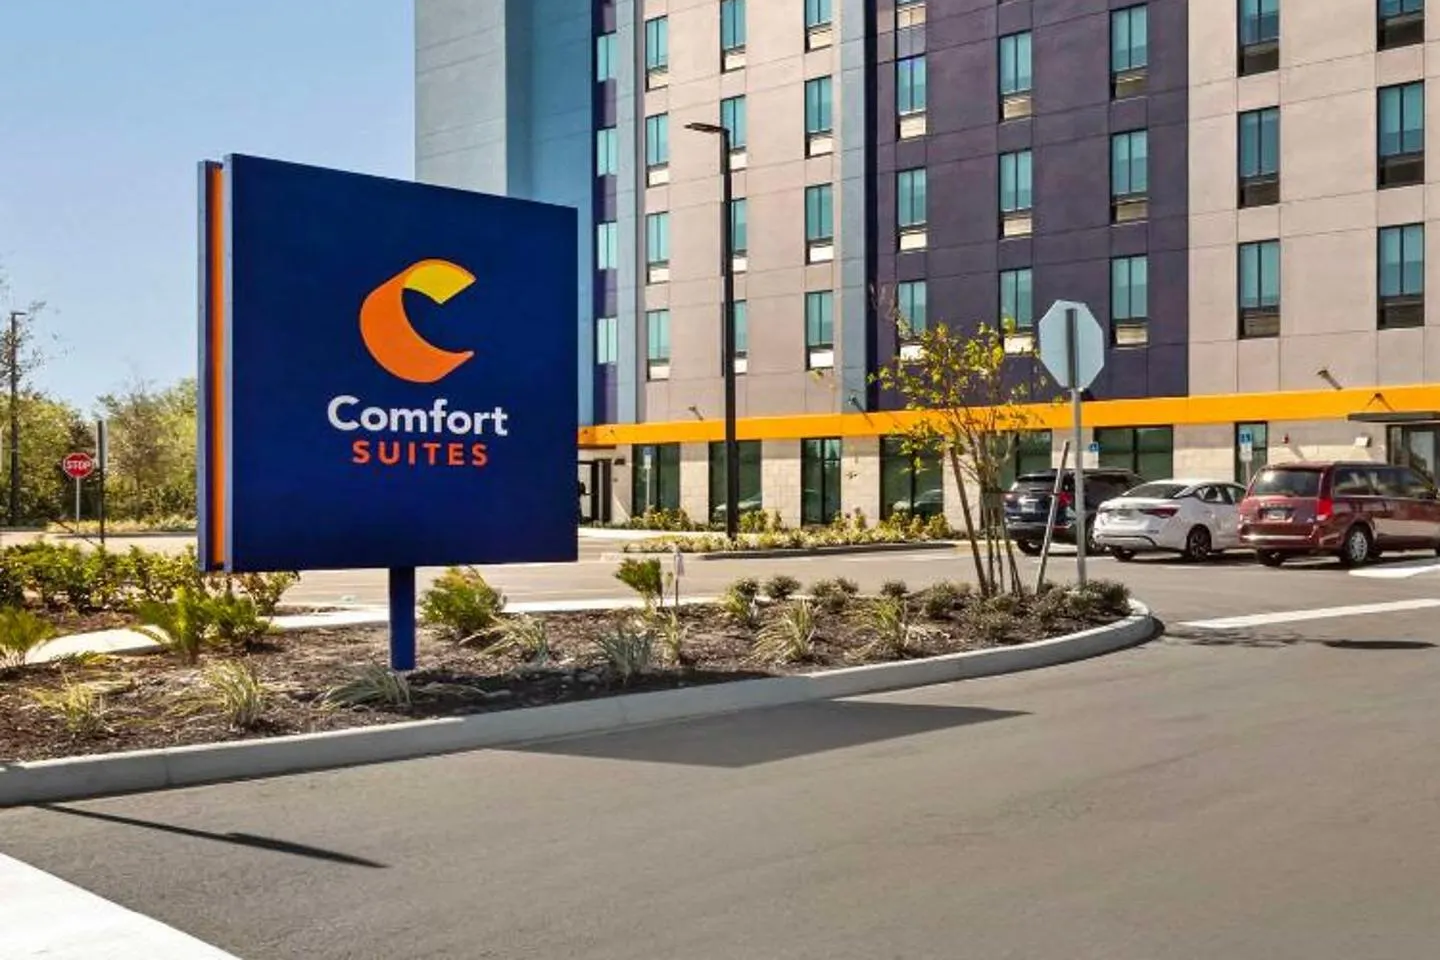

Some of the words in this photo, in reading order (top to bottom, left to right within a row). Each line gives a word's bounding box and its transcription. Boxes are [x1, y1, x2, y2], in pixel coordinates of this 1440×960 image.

[328, 395, 508, 436] Comfort
[66, 460, 91, 470] STOP
[352, 440, 488, 466] SUITES
